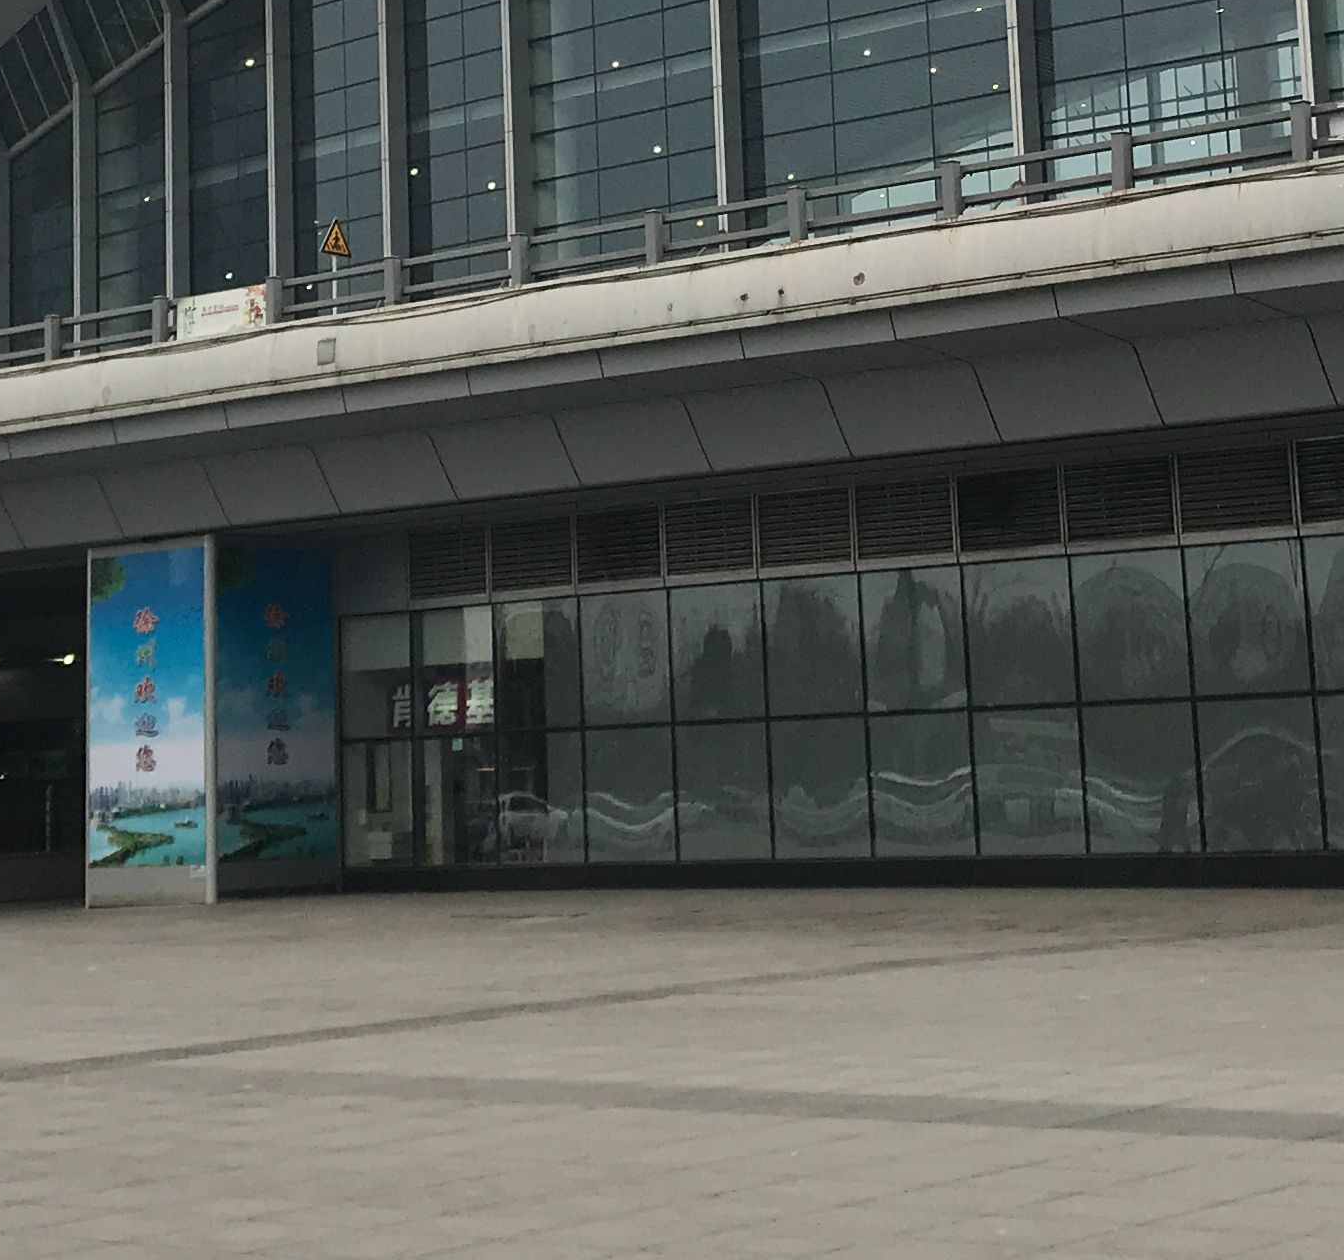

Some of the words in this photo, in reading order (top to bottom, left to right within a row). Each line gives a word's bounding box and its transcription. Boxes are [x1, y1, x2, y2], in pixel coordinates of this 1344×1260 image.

[133, 607, 159, 772] 徐州欢迎您
[392, 678, 495, 728] 肯德基
